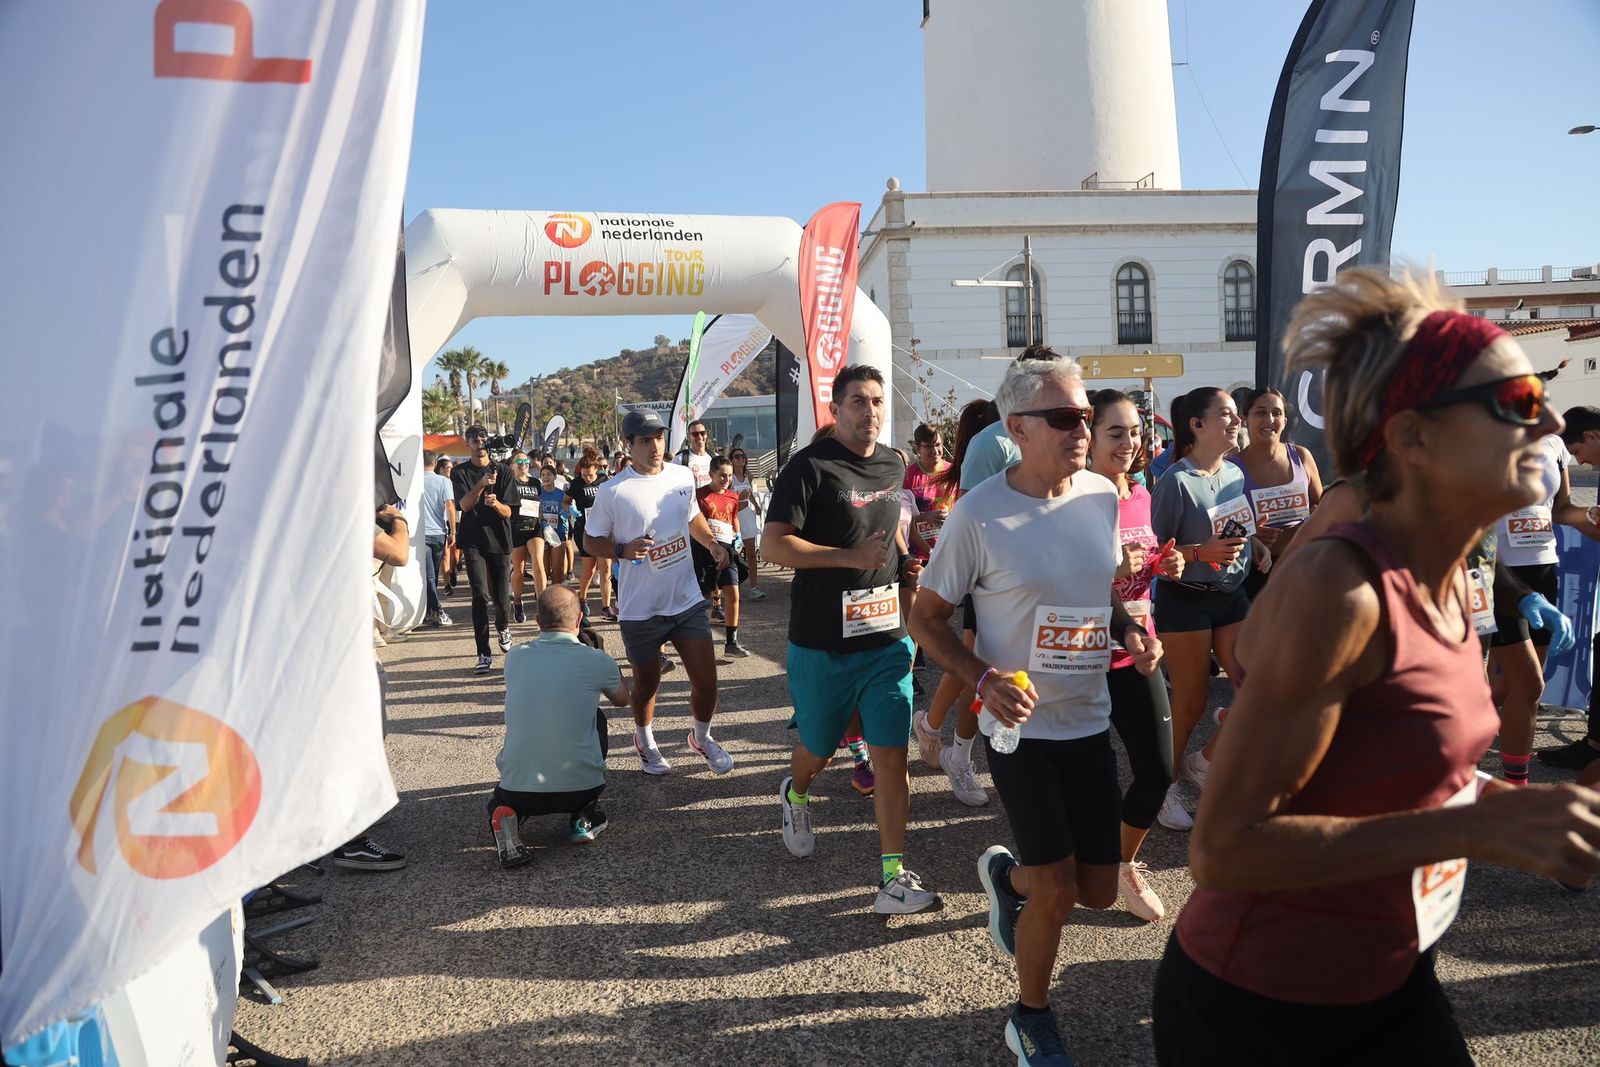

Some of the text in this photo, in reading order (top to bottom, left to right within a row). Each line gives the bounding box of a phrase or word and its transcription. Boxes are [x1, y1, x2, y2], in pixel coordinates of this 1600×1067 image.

[600, 217, 675, 227] nationale
[602, 229, 703, 241] nederlanden
[664, 249, 704, 261] TOUR
[544, 260, 705, 296] PLOGGING
[170, 203, 264, 654] nederlanden
[131, 326, 190, 653] nationale
[1261, 496, 1303, 512] 24379
[652, 539, 685, 560] 24376
[851, 600, 895, 619] 24391
[1040, 628, 1106, 649] 24400
